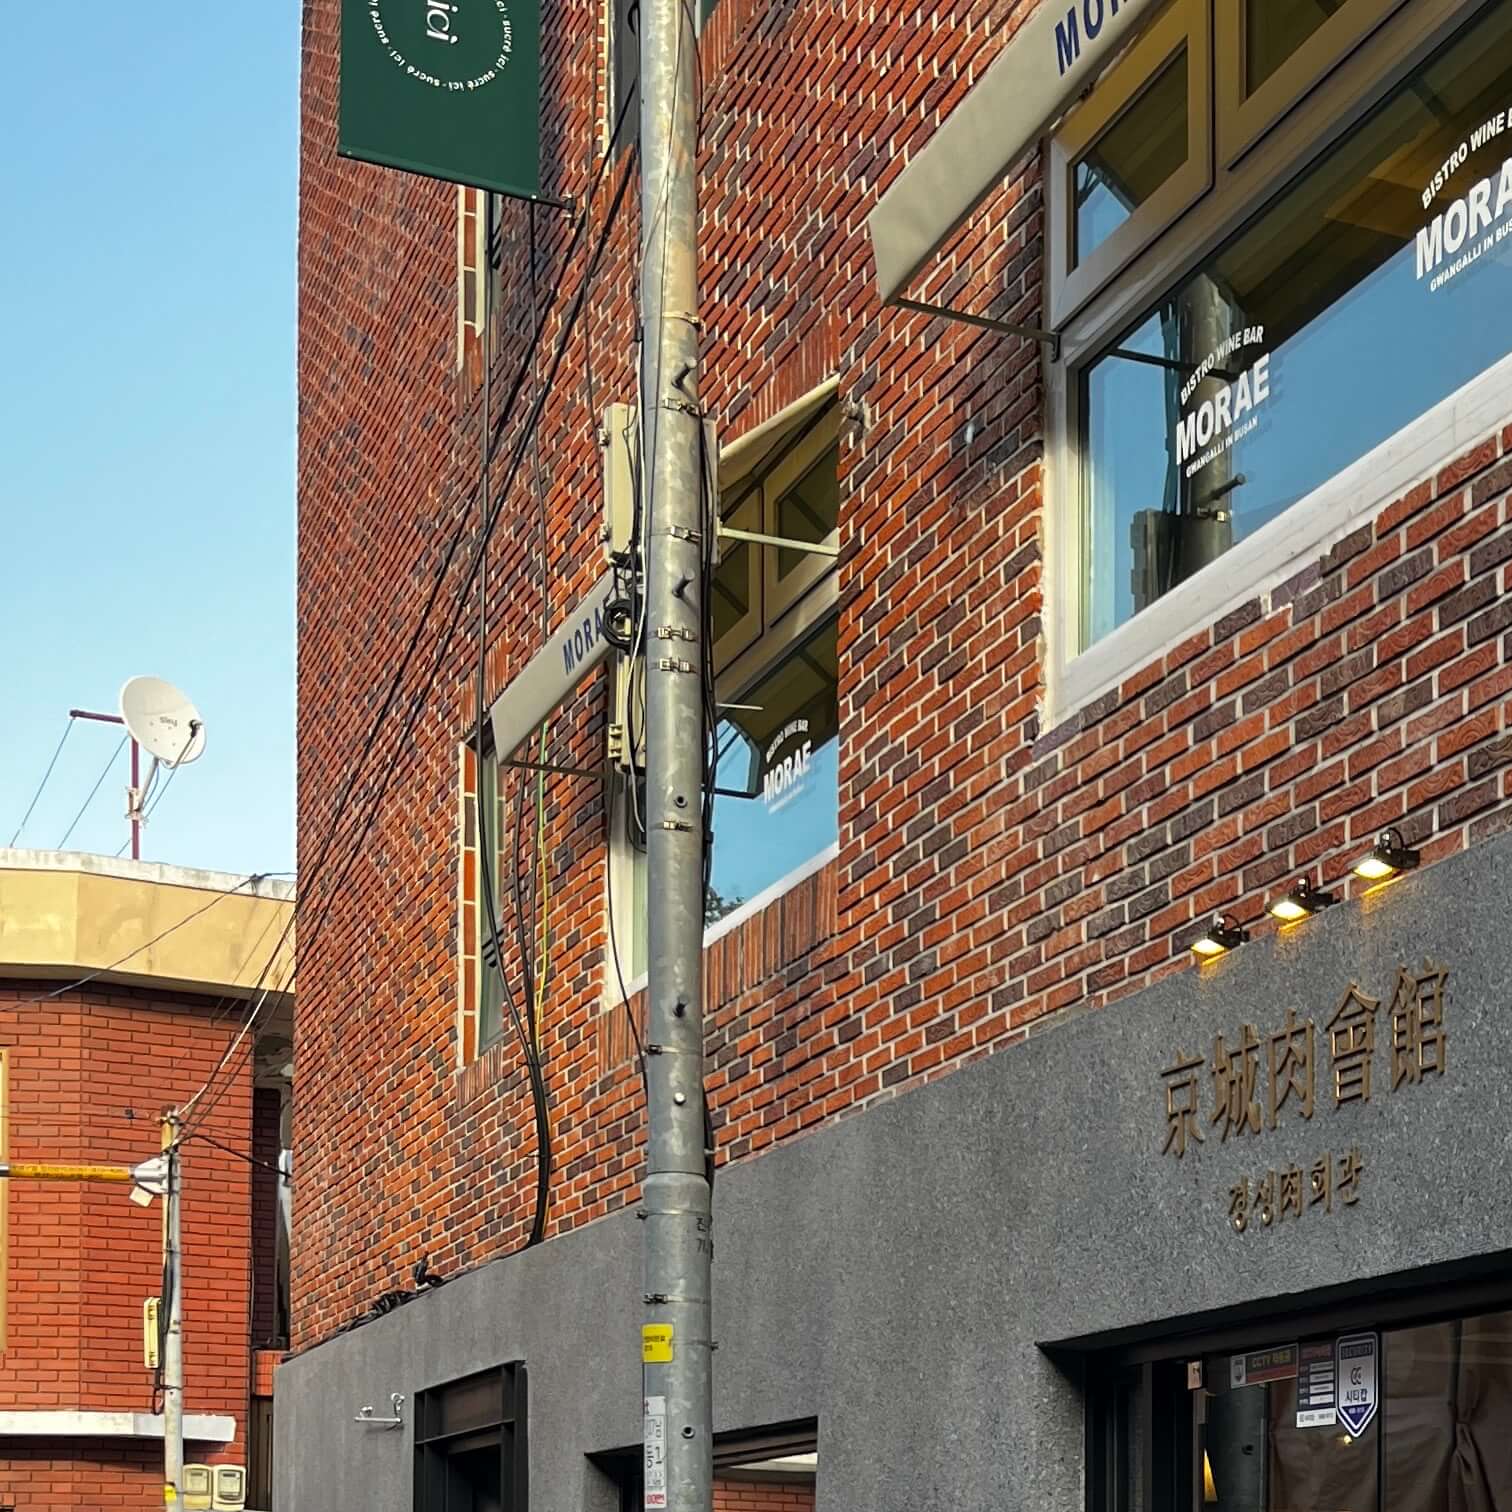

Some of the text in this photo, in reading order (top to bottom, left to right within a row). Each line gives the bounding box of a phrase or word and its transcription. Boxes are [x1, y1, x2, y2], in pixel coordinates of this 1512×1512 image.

[1421, 142, 1468, 209] BISTRO
[1470, 111, 1505, 152] WINE
[1430, 248, 1482, 292] GWANGALLI
[1483, 234, 1494, 252] IN
[1176, 352, 1270, 465] MORAE
[1180, 325, 1264, 406] BISTRO WINE BAR
[1160, 957, 1449, 1159] 京城肉會館
